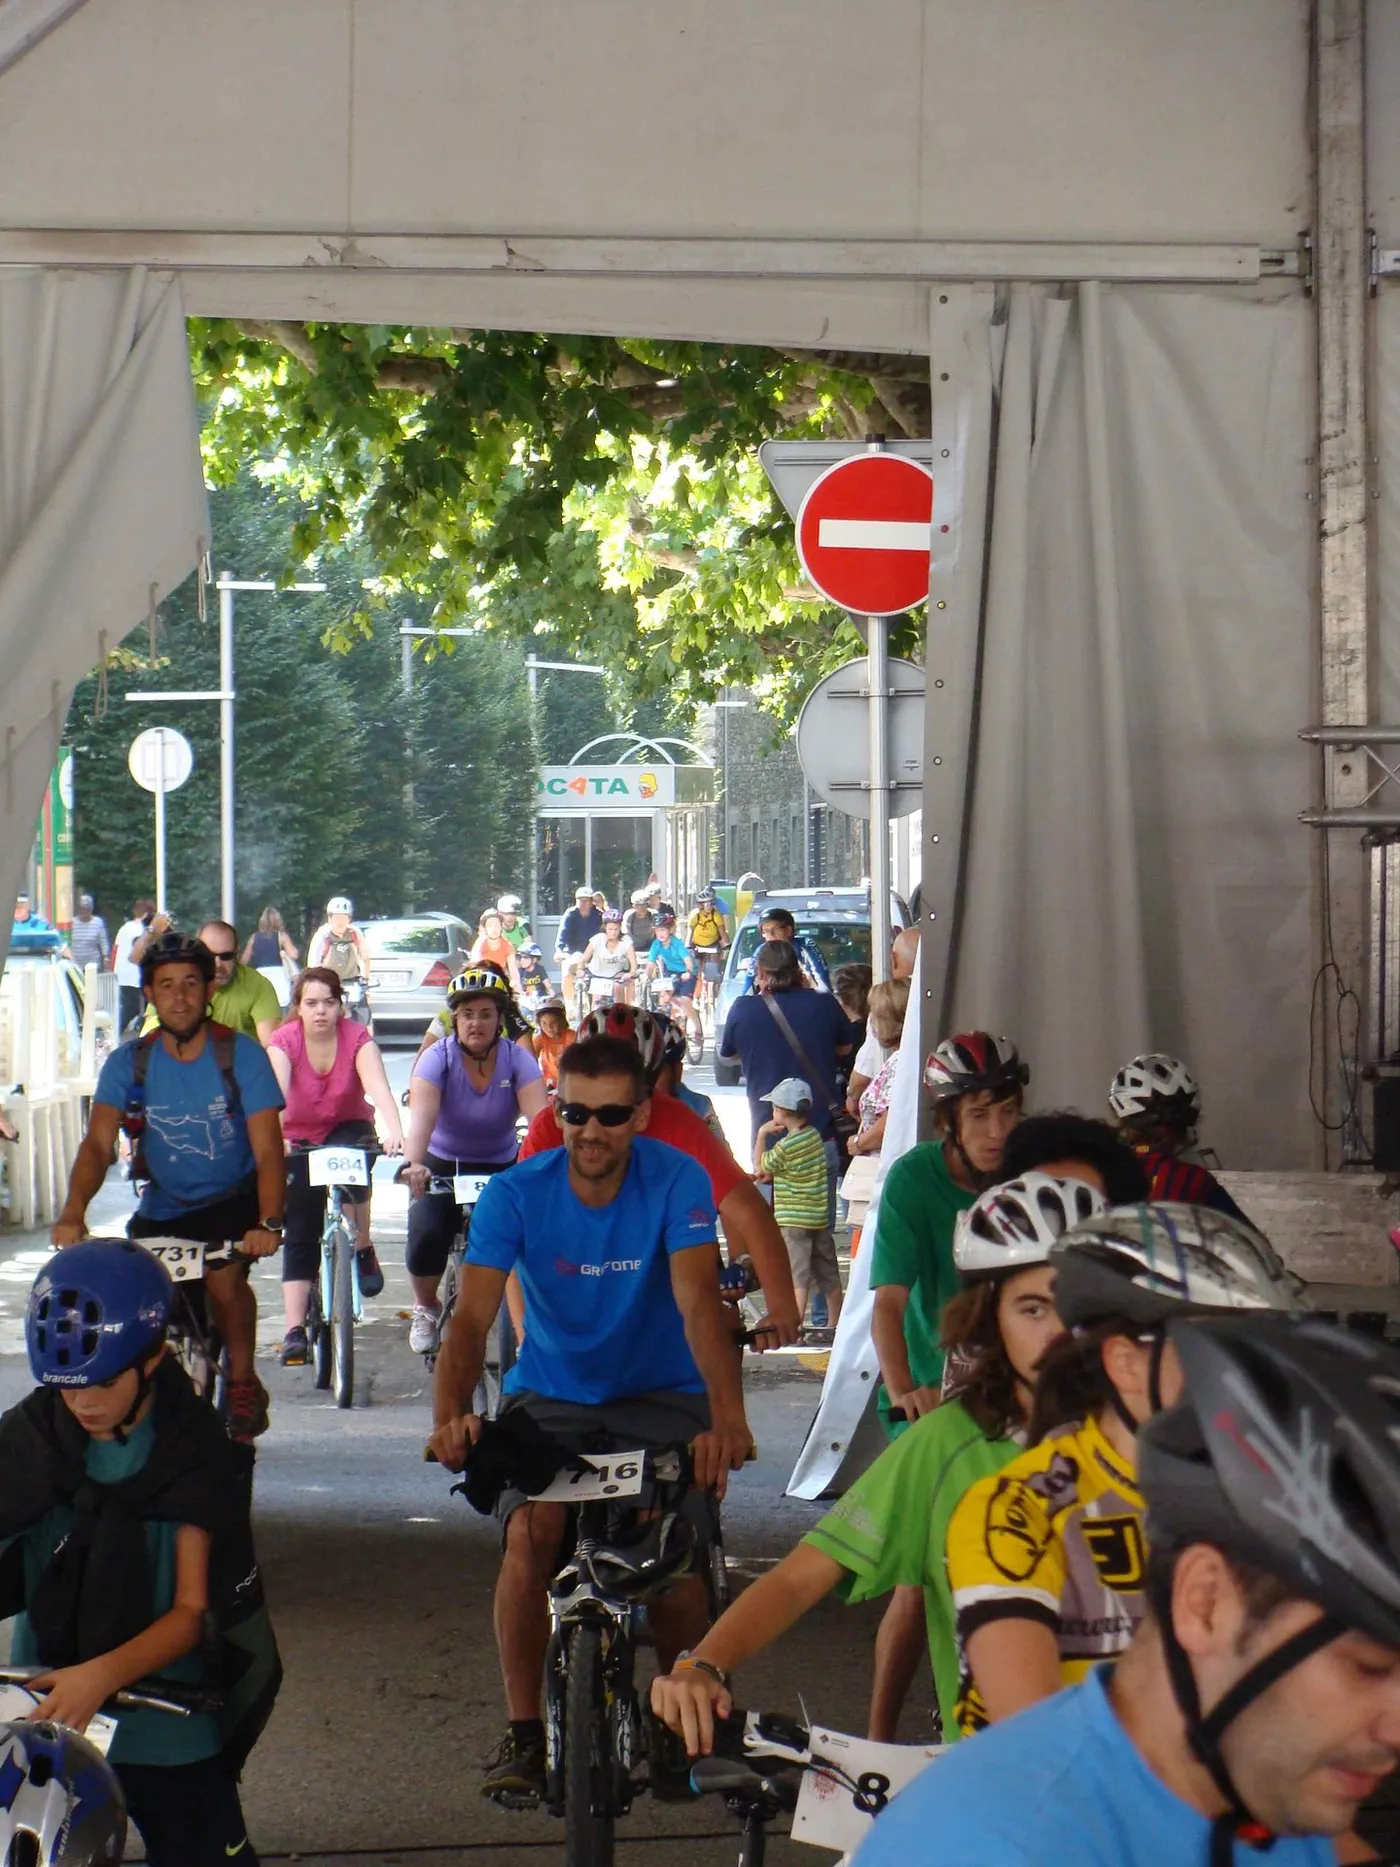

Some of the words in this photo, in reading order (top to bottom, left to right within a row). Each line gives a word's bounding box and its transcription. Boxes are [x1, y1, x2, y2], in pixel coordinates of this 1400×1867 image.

[327, 1156, 364, 1172] 684
[151, 1246, 198, 1262] 731
[42, 1371, 88, 1385] brancale
[569, 1462, 639, 1485] 716
[853, 1771, 891, 1816] 8
